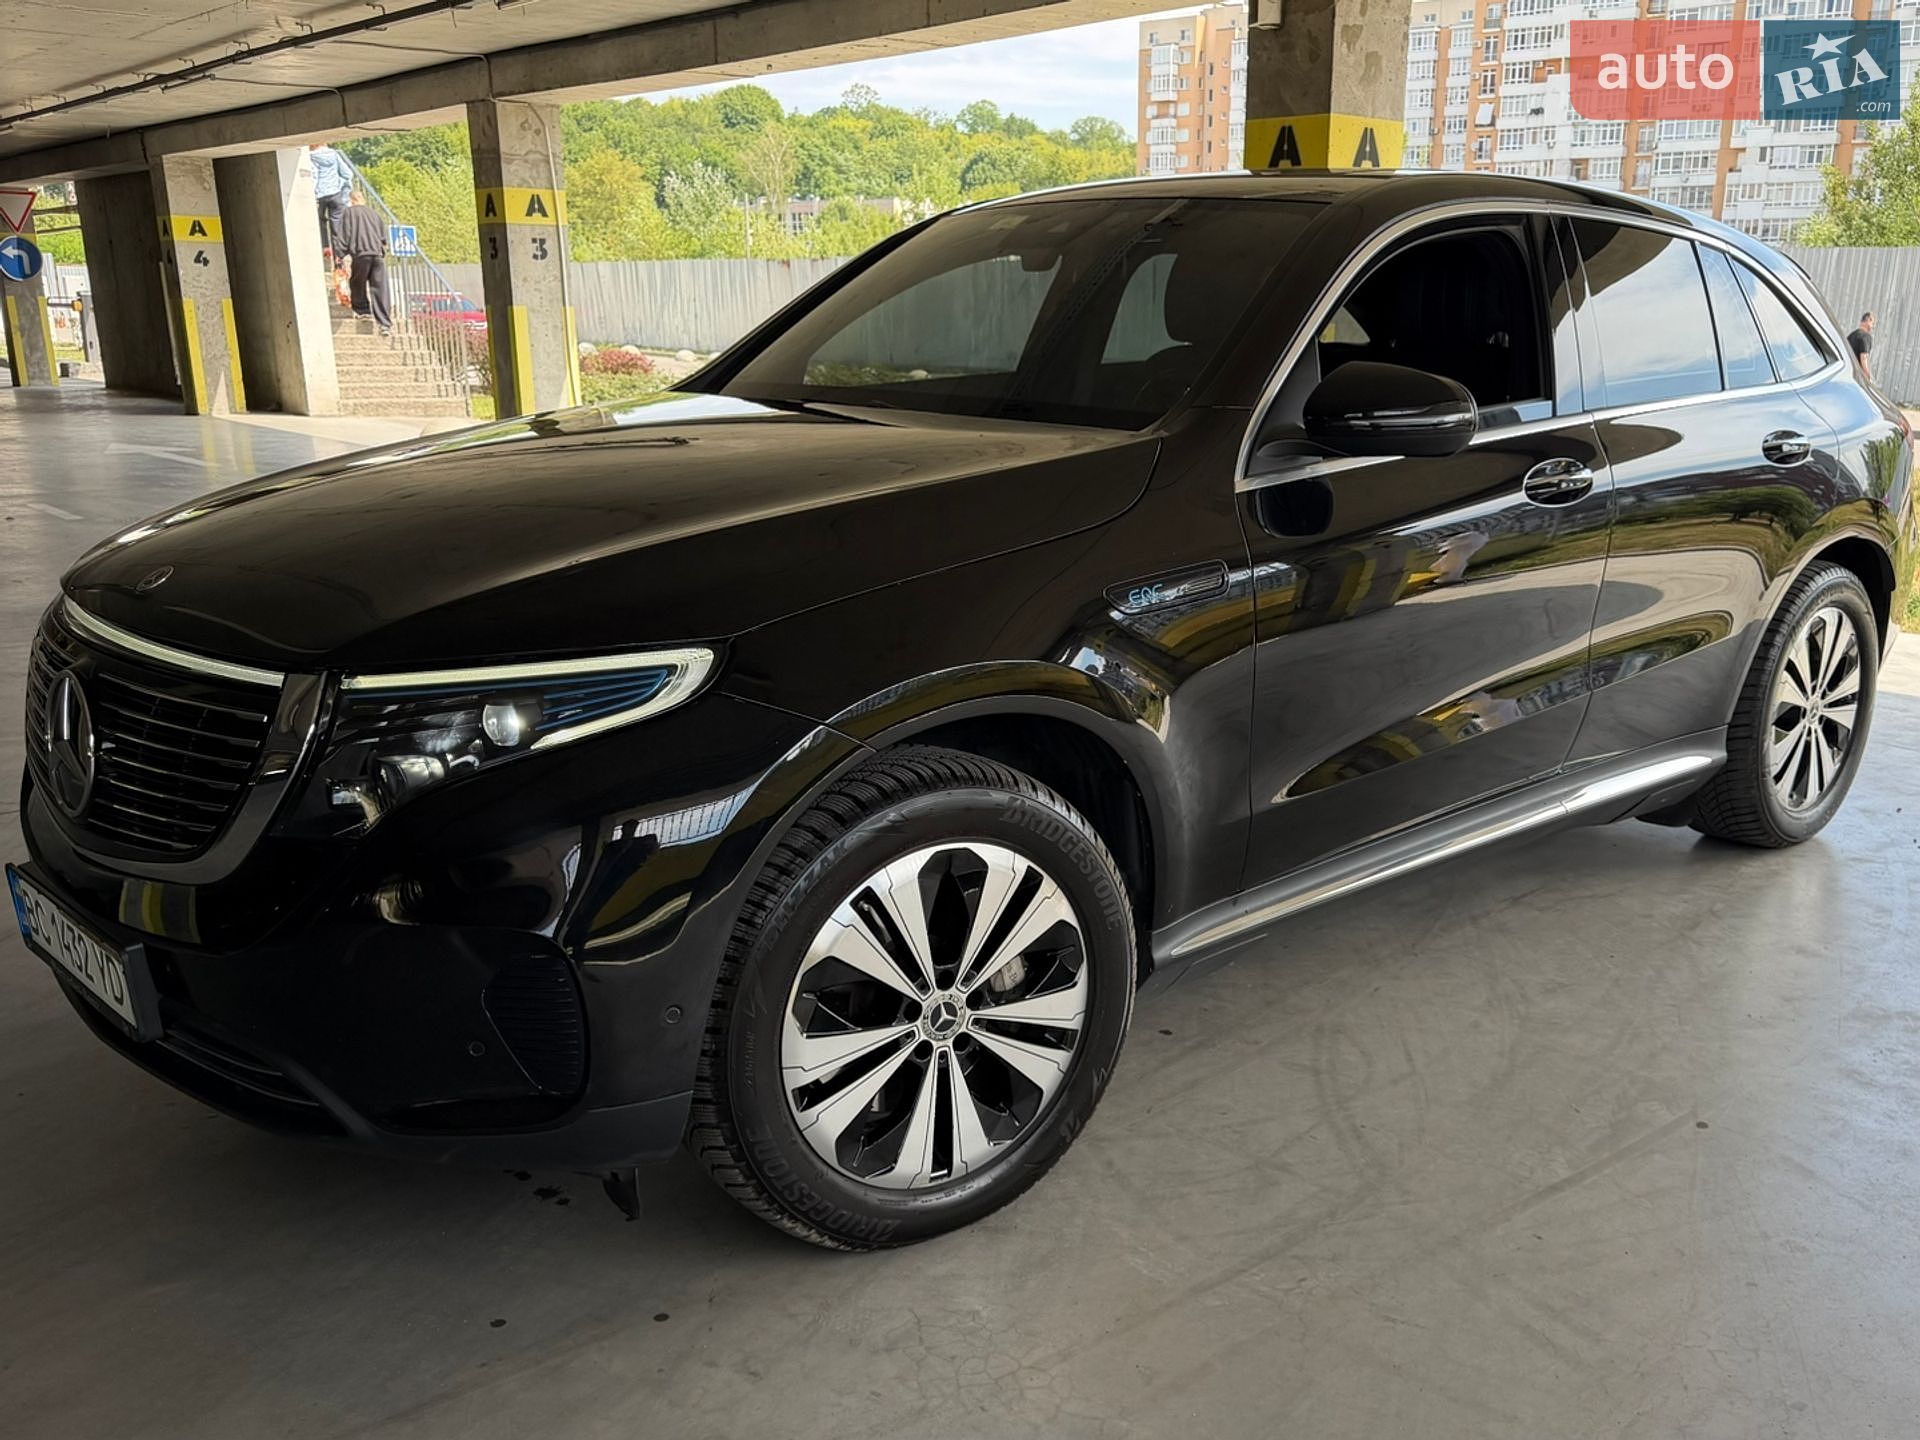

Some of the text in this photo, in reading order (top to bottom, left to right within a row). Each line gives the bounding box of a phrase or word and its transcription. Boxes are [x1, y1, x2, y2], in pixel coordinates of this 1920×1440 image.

[1268, 125, 1301, 168] A
[1352, 127, 1380, 168] A
[485, 193, 498, 217] A
[525, 194, 549, 217] A
[188, 219, 208, 237] A
[193, 250, 210, 267] 4
[489, 237, 498, 260] 3
[531, 238, 548, 261] 3
[1000, 796, 1122, 931] BRIDGESTONE
[22, 889, 51, 946] BC
[51, 912, 95, 983] 1432
[747, 1123, 902, 1241] BRIDGESTONE
